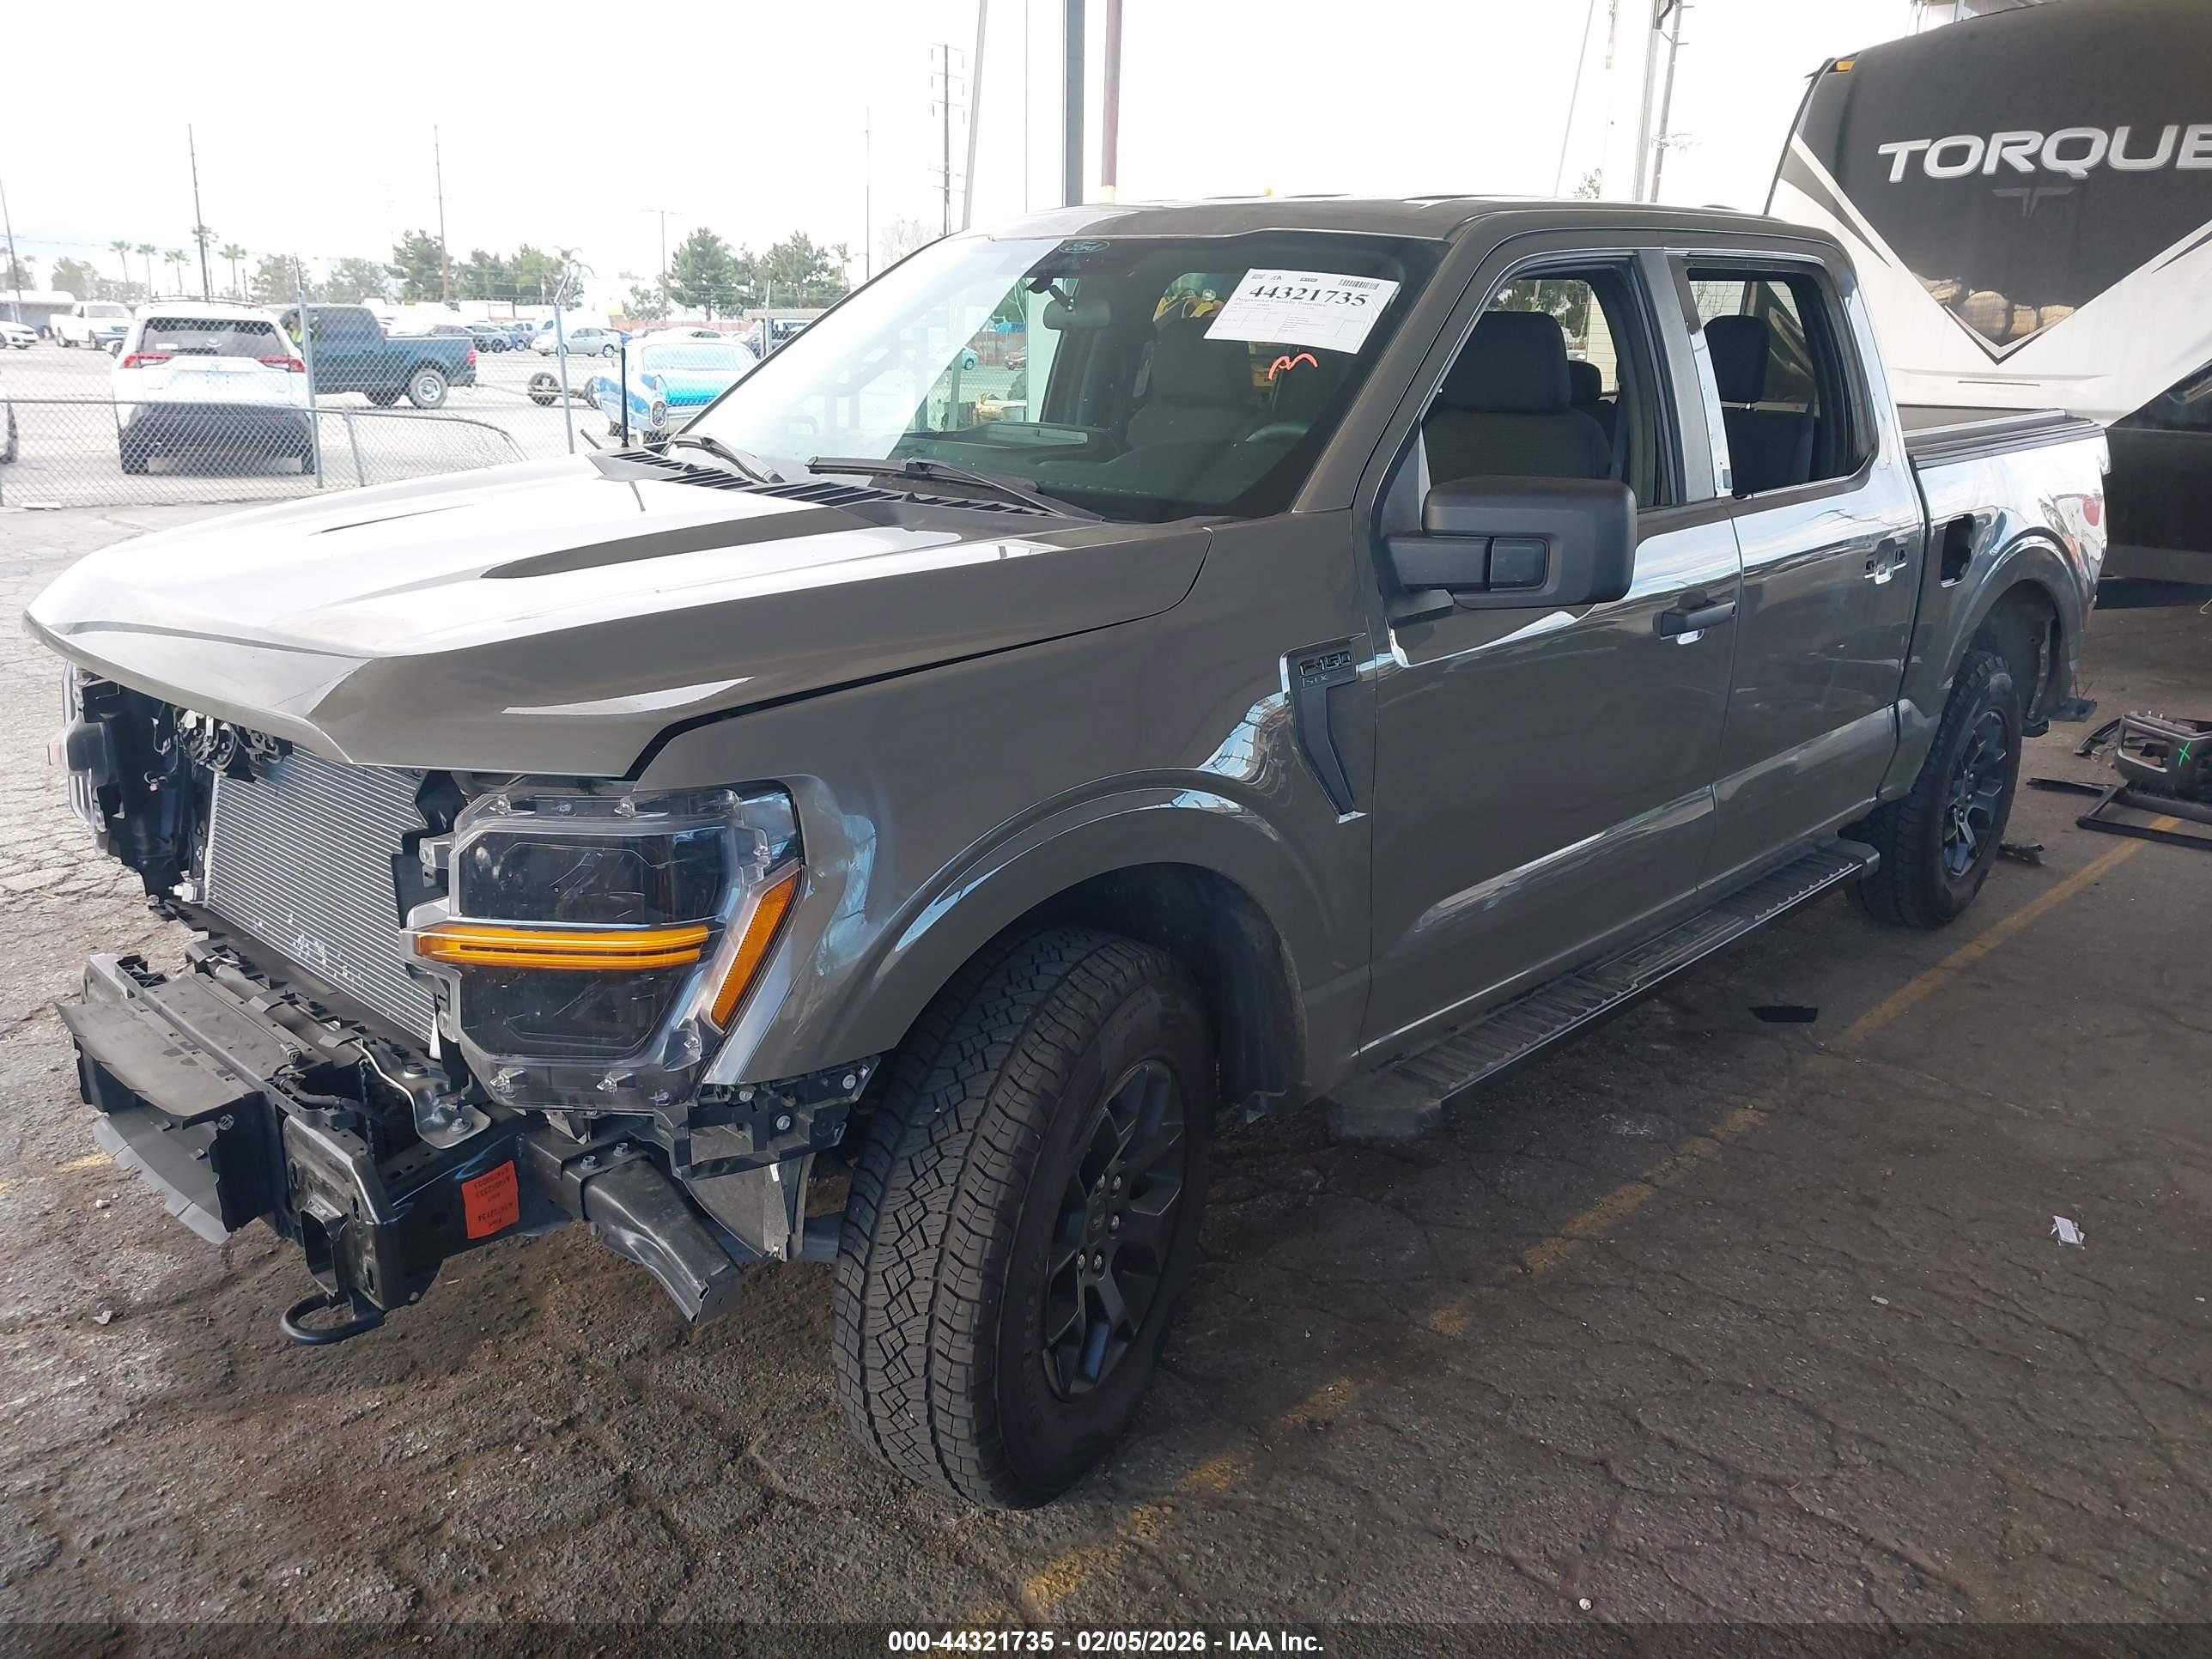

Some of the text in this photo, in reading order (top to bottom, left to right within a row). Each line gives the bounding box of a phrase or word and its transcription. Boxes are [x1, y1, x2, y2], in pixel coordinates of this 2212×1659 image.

[1878, 125, 2212, 183] TORQUE
[1249, 285, 1370, 307] 44321735
[1299, 652, 1351, 676] F-150
